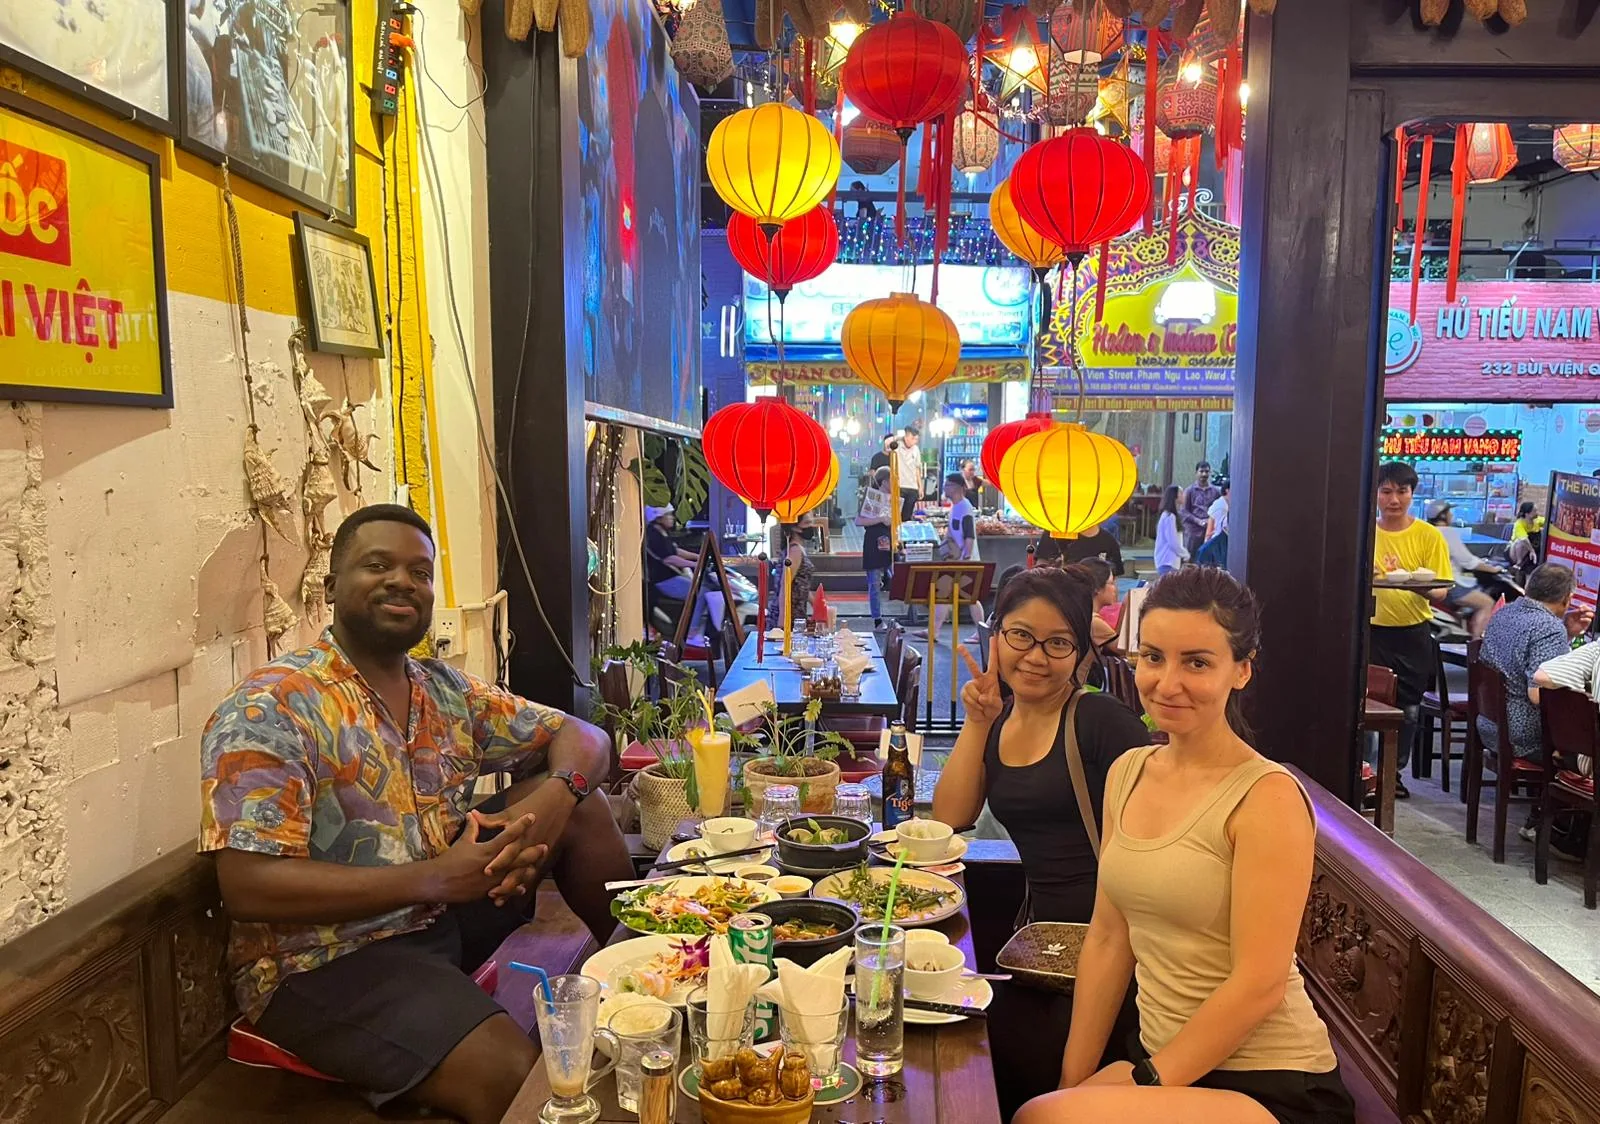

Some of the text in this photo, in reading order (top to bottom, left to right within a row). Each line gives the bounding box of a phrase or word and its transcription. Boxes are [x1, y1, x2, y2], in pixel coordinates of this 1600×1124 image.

[23, 278, 123, 364] VIỆT
[1436, 295, 1471, 339] HỦ
[1478, 294, 1528, 339] TIẾU
[1533, 306, 1592, 339] NAM
[829, 367, 861, 379] CU
[1165, 369, 1180, 383] Ngu
[1481, 361, 1513, 376] 232
[1516, 358, 1543, 376] BÙI
[1549, 359, 1584, 378] VIỆN
[1431, 437, 1462, 455] NAM
[1560, 479, 1600, 498] THE RIC
[1551, 541, 1566, 553] Best
[1566, 545, 1583, 557] Price
[891, 797, 914, 812] Tige
